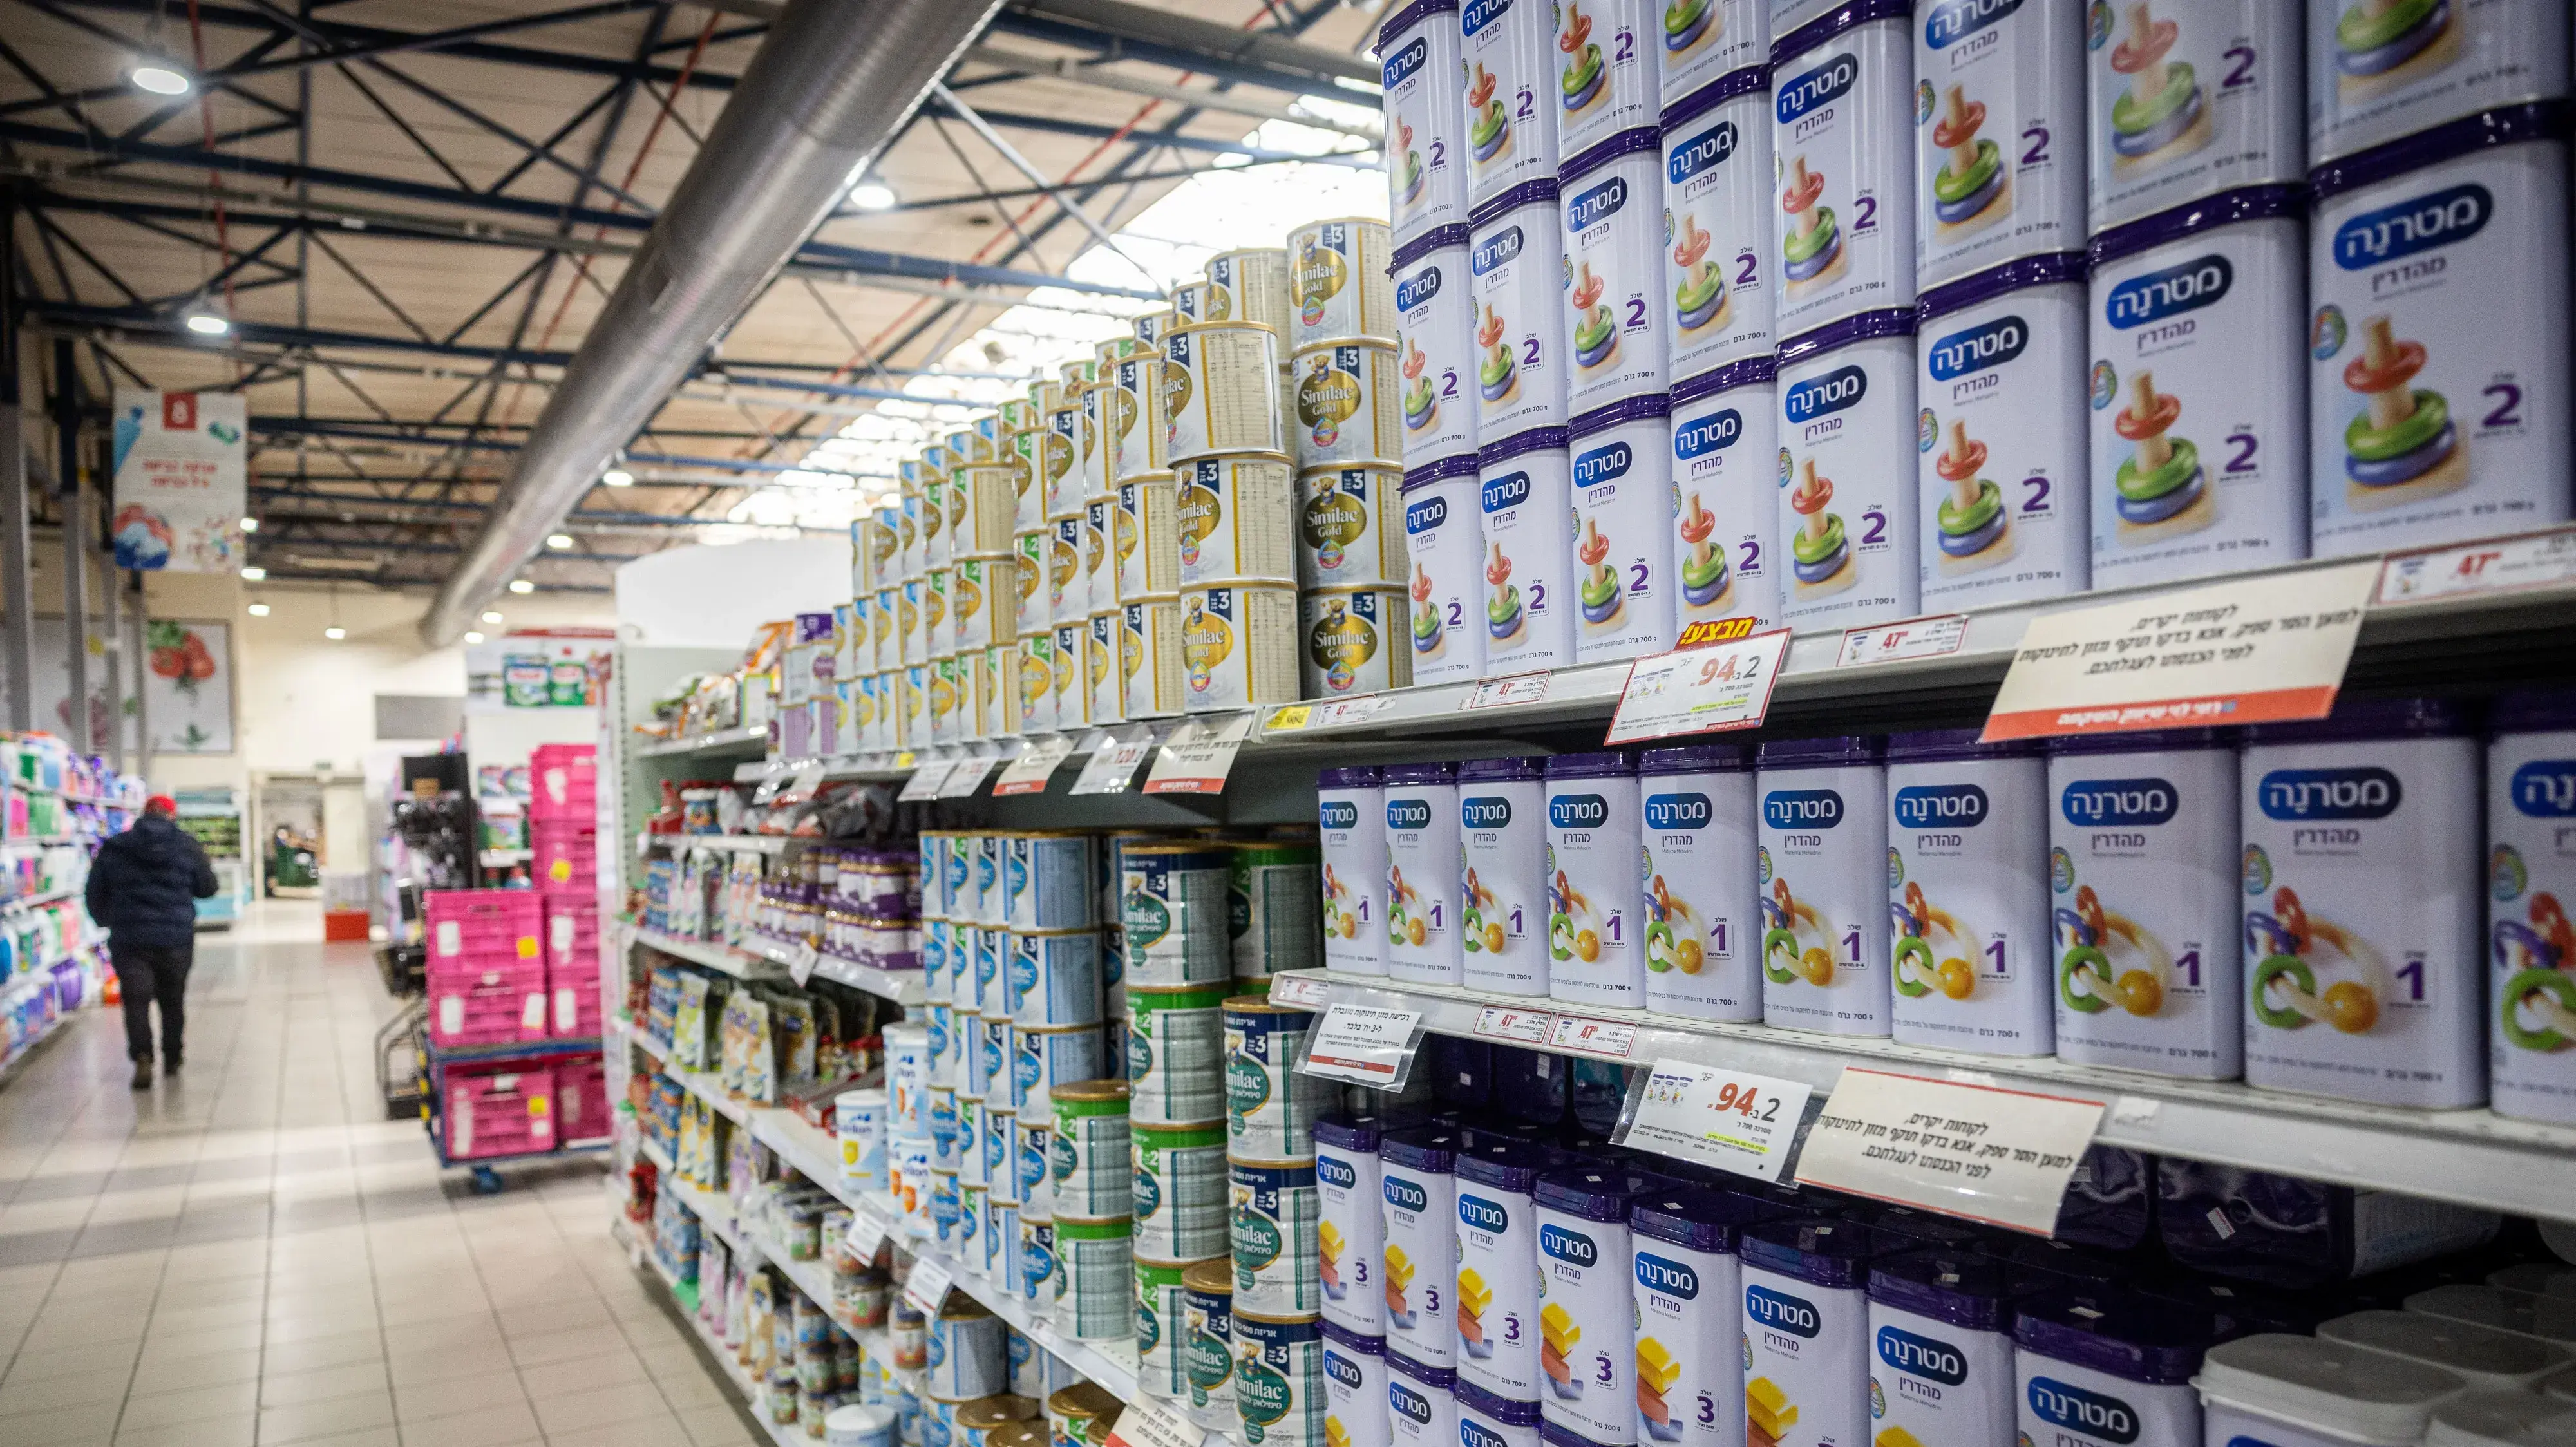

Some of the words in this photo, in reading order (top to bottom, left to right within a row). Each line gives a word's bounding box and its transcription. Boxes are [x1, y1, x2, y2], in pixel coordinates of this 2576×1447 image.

[1475, 22, 1501, 48] מהדרין
[1618, 24, 1629, 33] שלב
[1951, 31, 1998, 66] מהדרין
[1385, 44, 1424, 83] מטרנה
[1394, 77, 1416, 101] מהדרין
[1782, 64, 1851, 109] מטרנה
[1517, 91, 1533, 118] 2
[1672, 130, 1732, 175] מטרנה
[2022, 128, 2049, 164] 2
[1569, 186, 1622, 225] מטרנה
[1332, 226, 1344, 243] 3
[1581, 222, 1609, 246] מהדרין
[2346, 197, 2479, 256] מטרנה
[1736, 254, 1756, 284] 2
[1399, 273, 1437, 305] מטרנה
[2116, 265, 2222, 317] מטרנה
[1347, 350, 1358, 366] 3
[1937, 325, 2020, 372] מטרנה
[1301, 385, 1352, 406] Similac
[1790, 375, 1859, 413] מטרנה
[2482, 384, 2521, 428] 2
[1312, 403, 1336, 415] Gold
[1680, 418, 1735, 451] מטרנה
[1805, 417, 1842, 440] מהדרין
[1577, 451, 1626, 480] מטרנה
[1692, 456, 1722, 476] מהדרין
[2225, 435, 2258, 473] 2
[1207, 464, 1217, 481] 3
[1352, 473, 1363, 490] 3
[1483, 478, 1526, 515] מטרנה
[1588, 485, 1615, 504] מהדרין
[2022, 477, 2050, 512] 2
[1307, 507, 1358, 527] Similac
[1862, 512, 1885, 544] 2
[1318, 525, 1342, 538] Gold
[1630, 564, 1648, 591] 2
[1218, 592, 1229, 609] 3
[1363, 595, 1374, 612] 3
[1858, 598, 1871, 607] גרם
[1875, 596, 1889, 605] 700
[1315, 630, 1368, 647] Similac
[1680, 618, 1753, 645] מבצע!
[1327, 648, 1353, 659] Gold
[1698, 654, 1738, 686] 94
[1743, 655, 1761, 679] 2
[1902, 795, 1980, 822] מטרנה
[2071, 788, 2168, 820] מטרנה
[2271, 781, 2389, 813] מטרנה
[1322, 805, 1354, 825] מטרנה
[1465, 804, 1505, 825] מטרנה
[1554, 803, 1602, 824] מטרנה
[1651, 802, 1705, 824] מטרנה
[1662, 835, 1693, 847] מהדרין
[1785, 835, 1821, 847] מהדרין
[1156, 875, 1166, 891] 3
[1510, 909, 1522, 932] 1
[1711, 924, 1725, 951] 1
[1986, 940, 2005, 972] 1
[2397, 962, 2423, 1000] 1
[1332, 1007, 1354, 1015] מוגבלת
[1354, 1009, 1376, 1017] תינוקות
[1389, 1012, 1410, 1021] רכישת
[1256, 1036, 1266, 1053] 3
[1715, 1083, 1758, 1117] 94
[1761, 1097, 1780, 1122] 2
[1947, 1117, 1989, 1136] לקוחות
[1920, 1133, 1949, 1149] בדקו
[1952, 1139, 1976, 1153] אנא
[1150, 1151, 1159, 1166] 2
[1319, 1160, 1353, 1184] מטרנה
[1266, 1191, 1277, 1209] 3
[1463, 1198, 1503, 1227] מטרנה
[1470, 1231, 1493, 1245] מהדרין
[1545, 1229, 1591, 1258] מטרנה
[1640, 1260, 1692, 1291] מטרנה
[1651, 1294, 1680, 1312] מהדרין
[1751, 1295, 1813, 1329] מטרנה
[1218, 1316, 1228, 1332] 3
[1504, 1318, 1519, 1341] 3
[1276, 1346, 1287, 1363] 3
[1884, 1336, 1959, 1376] מטרנה
[1327, 1355, 1359, 1382] מטרנה
[1596, 1356, 1612, 1381] 3
[1900, 1377, 1941, 1400] מהדרין
[1392, 1386, 1427, 1416] מטרנה
[1697, 1396, 1714, 1423] 3
[2036, 1388, 2130, 1433] מטרנה
